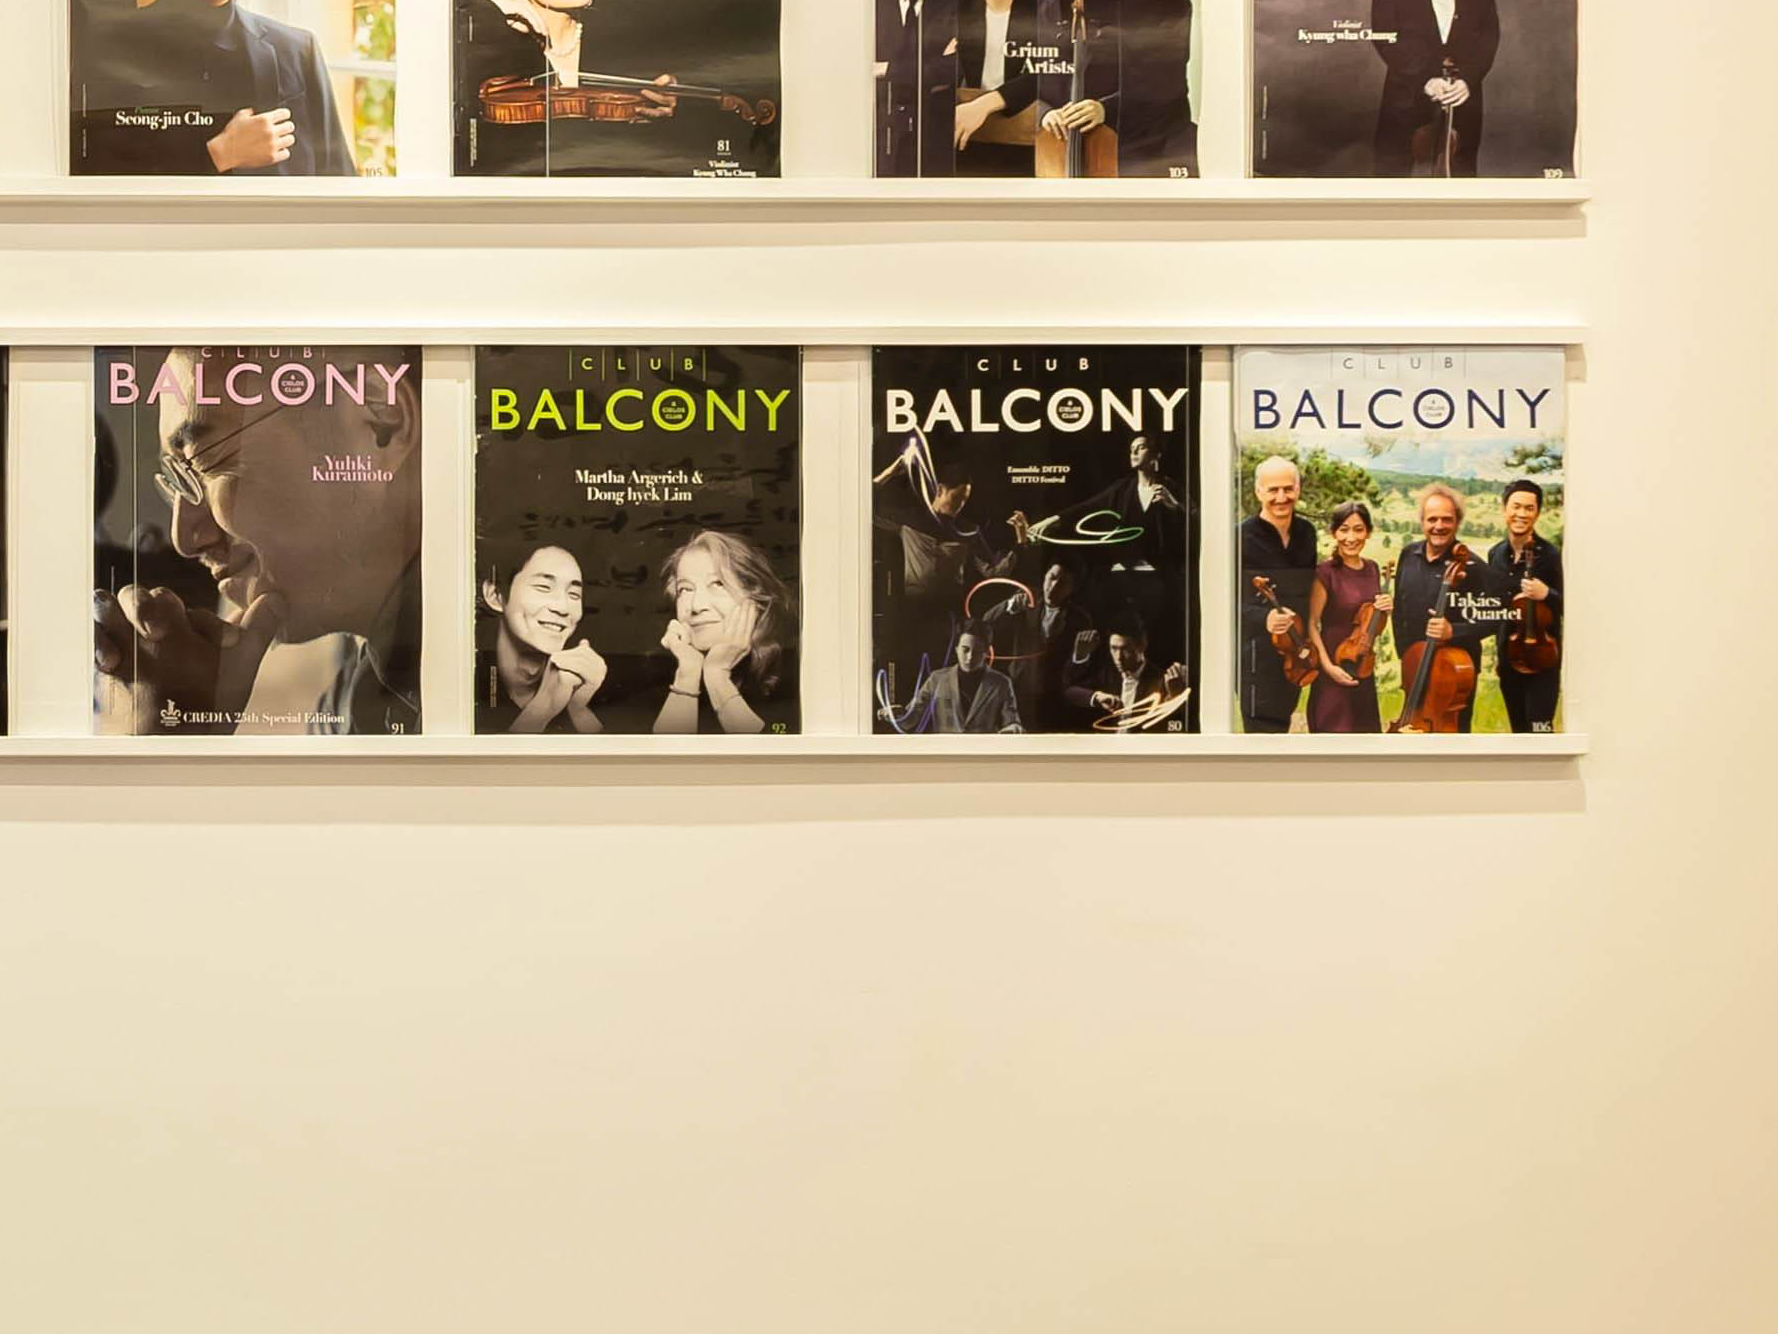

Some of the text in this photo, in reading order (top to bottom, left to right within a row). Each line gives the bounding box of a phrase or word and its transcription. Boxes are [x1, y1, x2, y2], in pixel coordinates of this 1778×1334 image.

[1003, 41, 1059, 58] G.rium
[1020, 58, 1076, 74] Artists
[115, 111, 214, 130] Seong-jin Cho
[717, 139, 731, 151] 81
[1168, 167, 1189, 178] 103
[201, 347, 312, 358] CLUB
[582, 358, 693, 370] CLUB
[977, 359, 1089, 371] CLUB
[1343, 357, 1453, 369] CLUB
[109, 363, 410, 405] BALCONY
[491, 388, 791, 431] BALCONY
[886, 388, 1189, 433] BALCONY
[1253, 389, 1550, 429] BALCONY
[324, 455, 372, 470] Yuhki
[1042, 465, 1071, 473] DITTO
[312, 466, 394, 482] Kuramoto
[574, 469, 703, 488] Martha Argerich &
[1011, 475, 1039, 483] DITTO
[587, 487, 624, 505] Dong
[663, 487, 693, 501] Lim
[1445, 592, 1501, 607] Takács
[1461, 606, 1522, 624] Quartet
[183, 712, 232, 723] CREDIA
[261, 712, 301, 726] Special
[304, 712, 345, 723] Edition
[1167, 720, 1182, 732] 80
[391, 723, 404, 734] 91
[771, 723, 787, 734] 92
